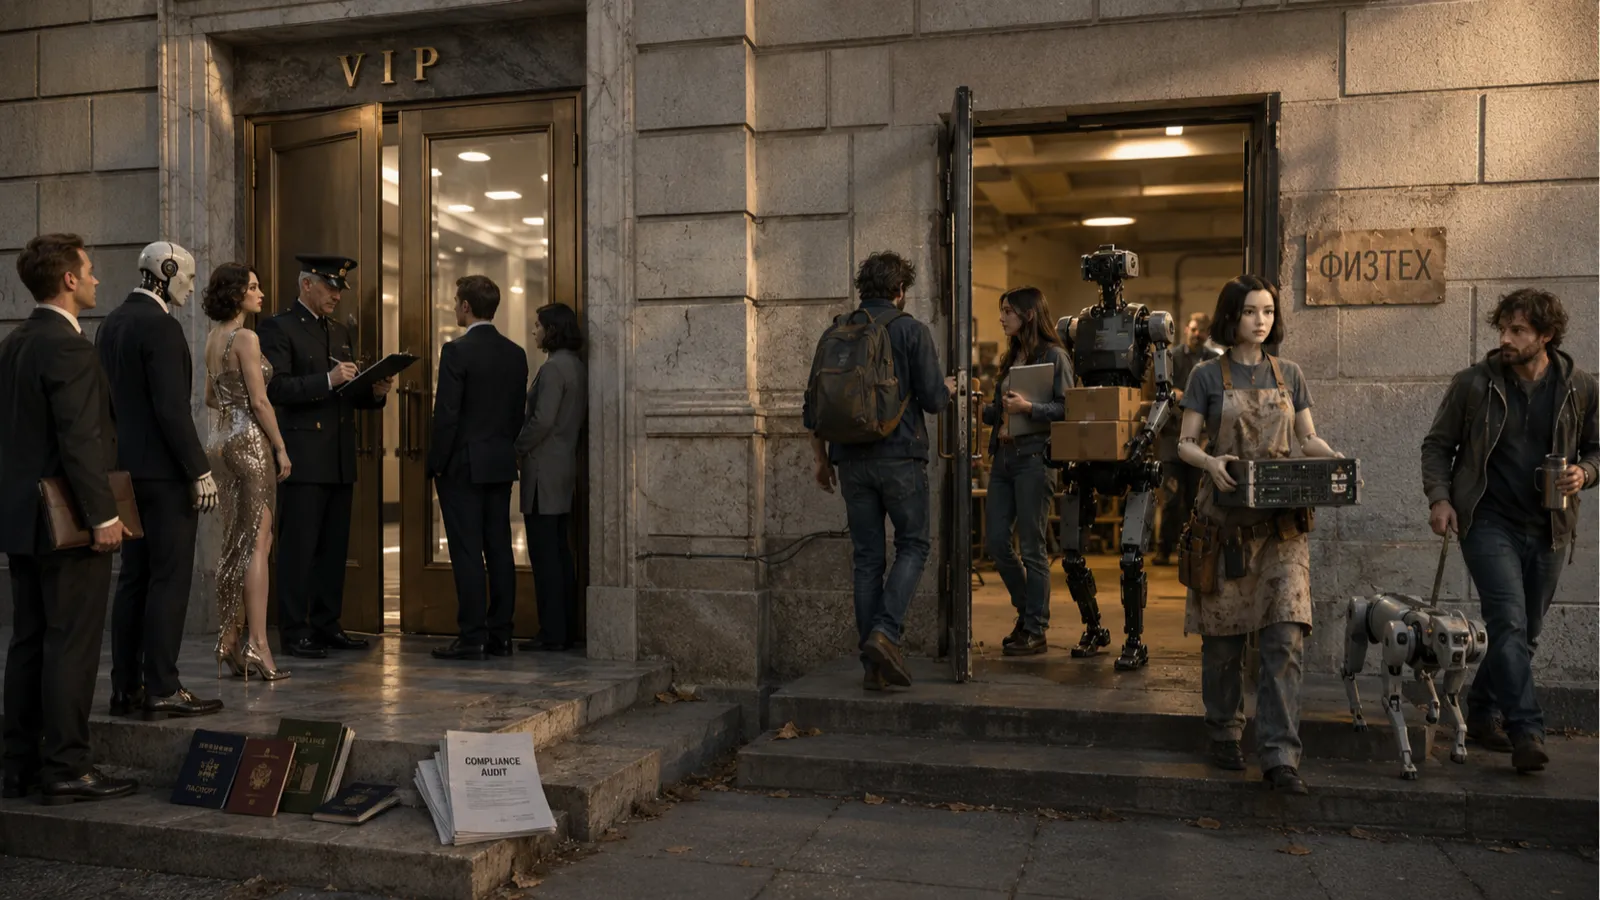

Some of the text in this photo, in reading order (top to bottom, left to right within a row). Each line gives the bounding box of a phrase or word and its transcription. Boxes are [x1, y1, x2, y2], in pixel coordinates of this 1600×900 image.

[337, 46, 439, 88] VIP
[1319, 249, 1432, 282] ФИЗТЕХ
[465, 756, 521, 766] COMPLIANCE
[481, 768, 508, 777] AUDIT
